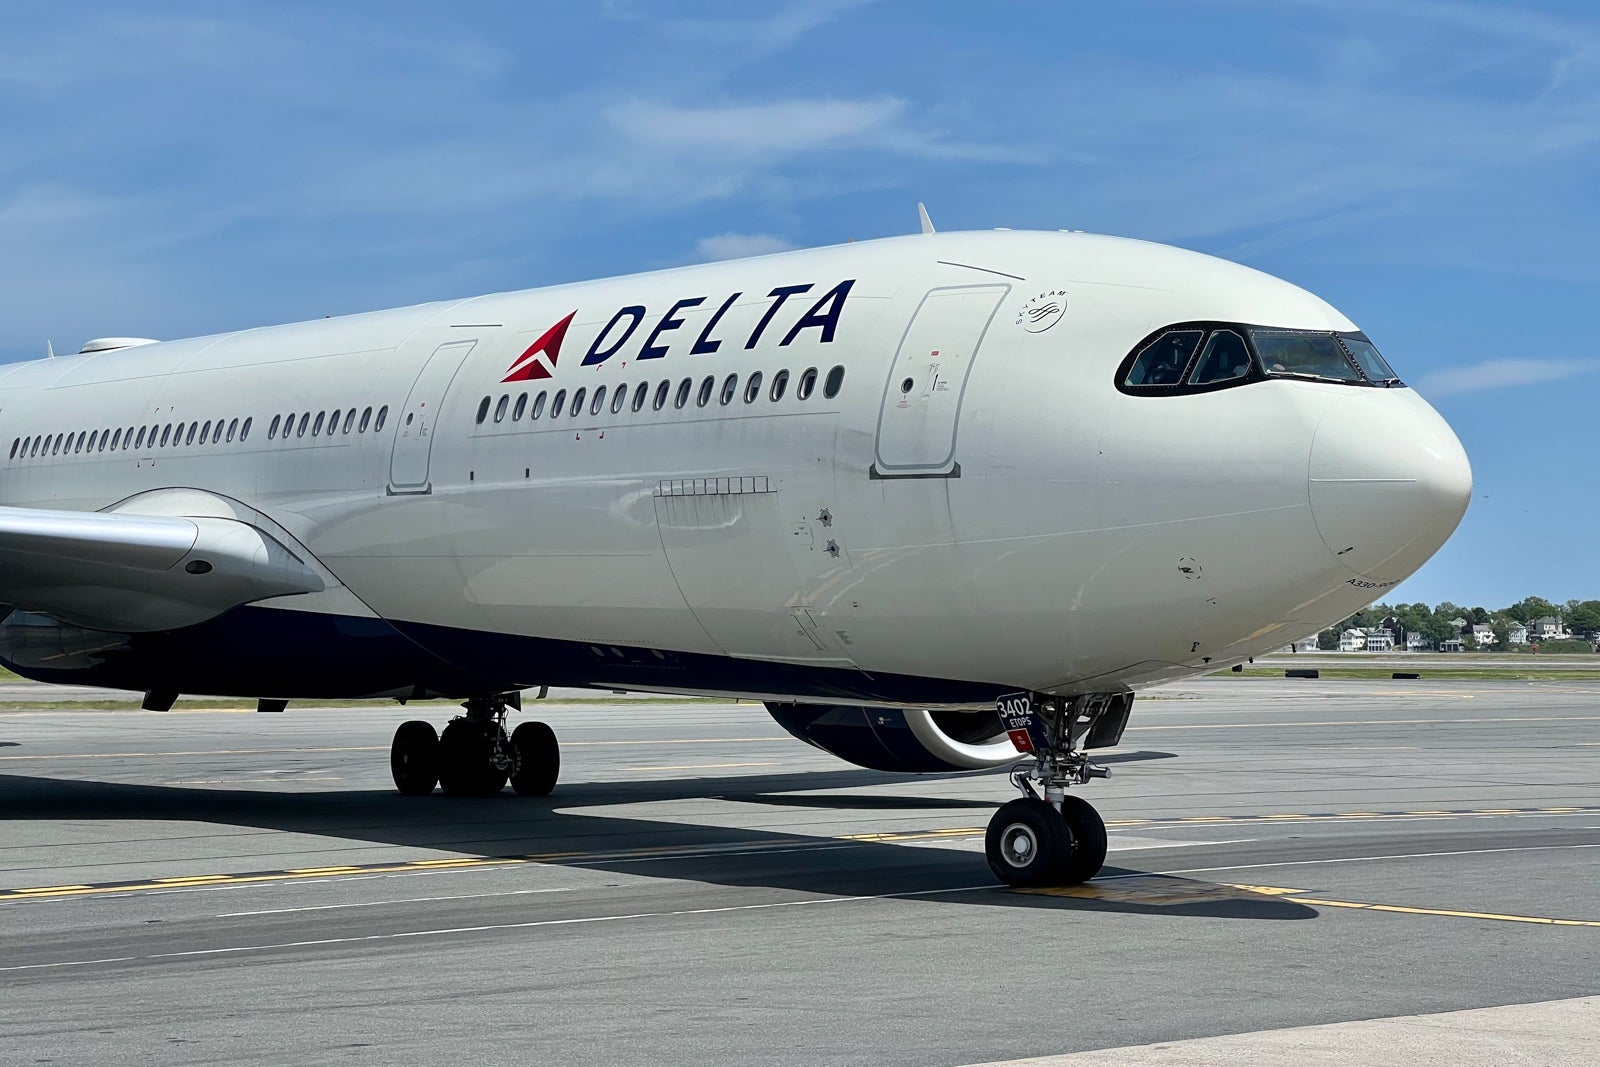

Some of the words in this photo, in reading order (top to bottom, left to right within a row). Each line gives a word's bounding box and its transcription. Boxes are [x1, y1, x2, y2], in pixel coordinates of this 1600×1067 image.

[1015, 290, 1067, 325] SKYTEAM
[580, 279, 856, 366] DELTA
[1345, 578, 1401, 589] A330-
[997, 698, 1034, 718] 3402
[1010, 716, 1032, 728] ETOPS
